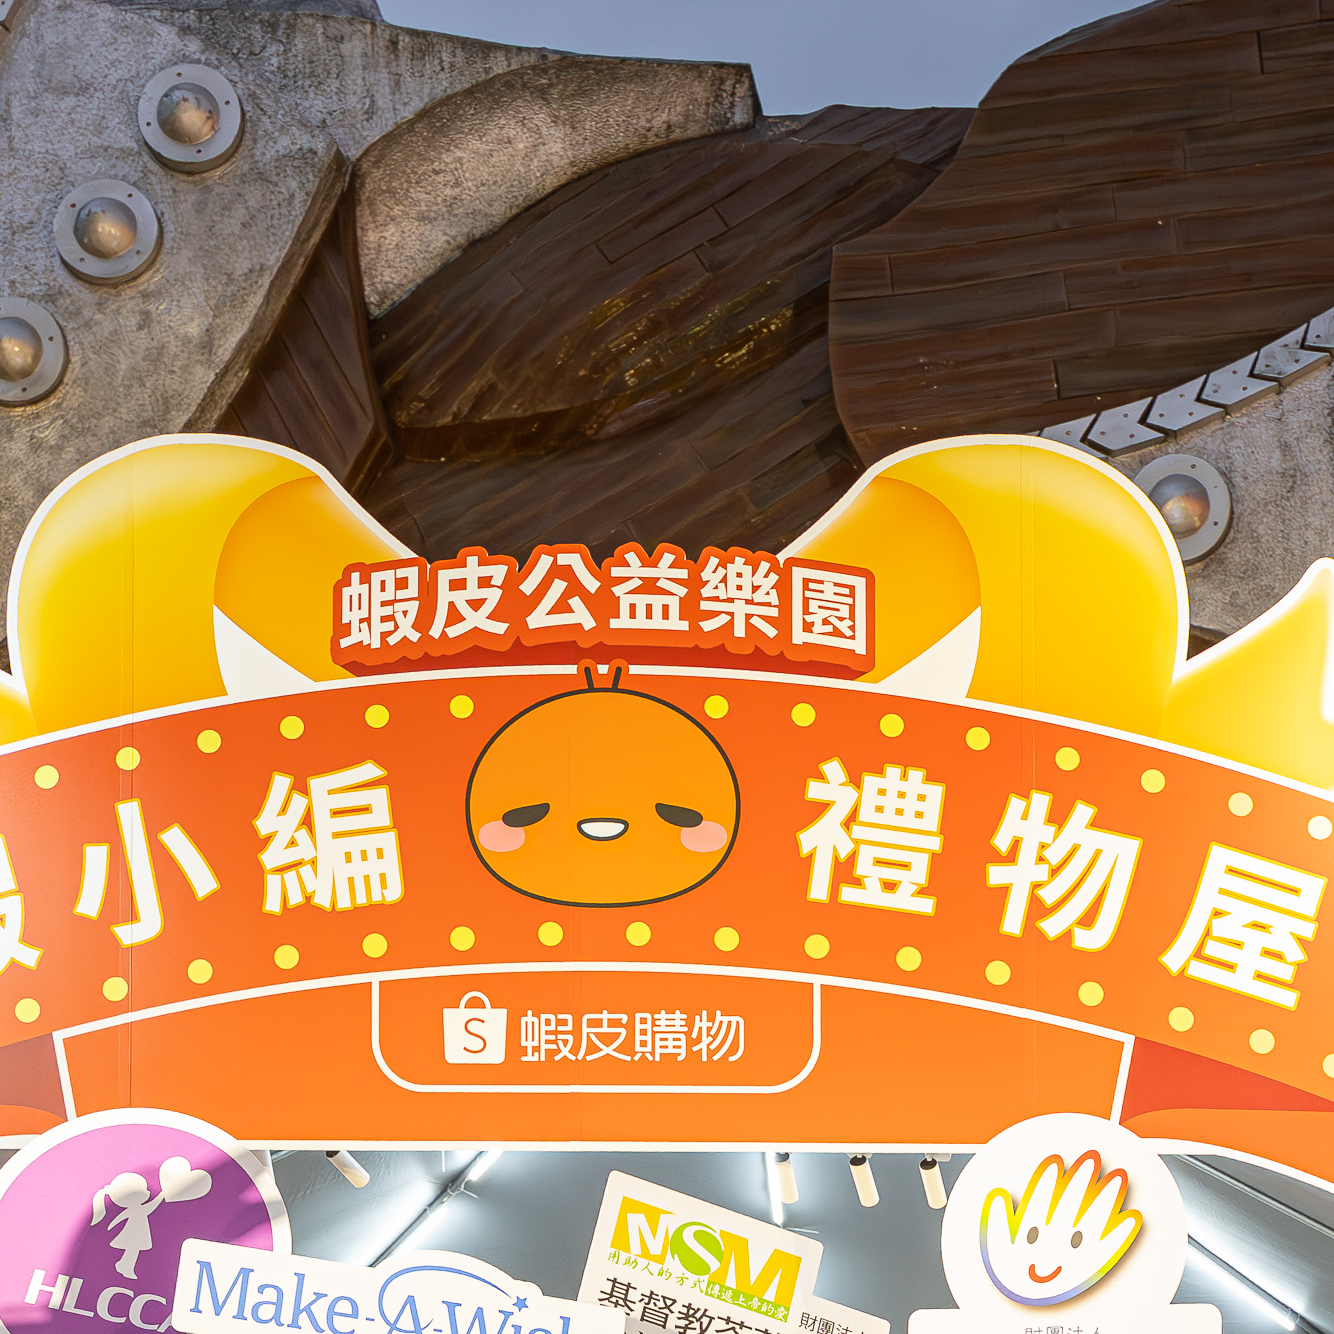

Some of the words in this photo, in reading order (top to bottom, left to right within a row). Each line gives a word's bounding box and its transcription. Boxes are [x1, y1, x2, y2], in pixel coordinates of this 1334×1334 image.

[338, 550, 868, 655] 蝦皮公益樂園
[796, 756, 1329, 1010] 禮物屋
[519, 1010, 746, 1062] 蝦皮購物
[613, 1199, 802, 1308] NSM
